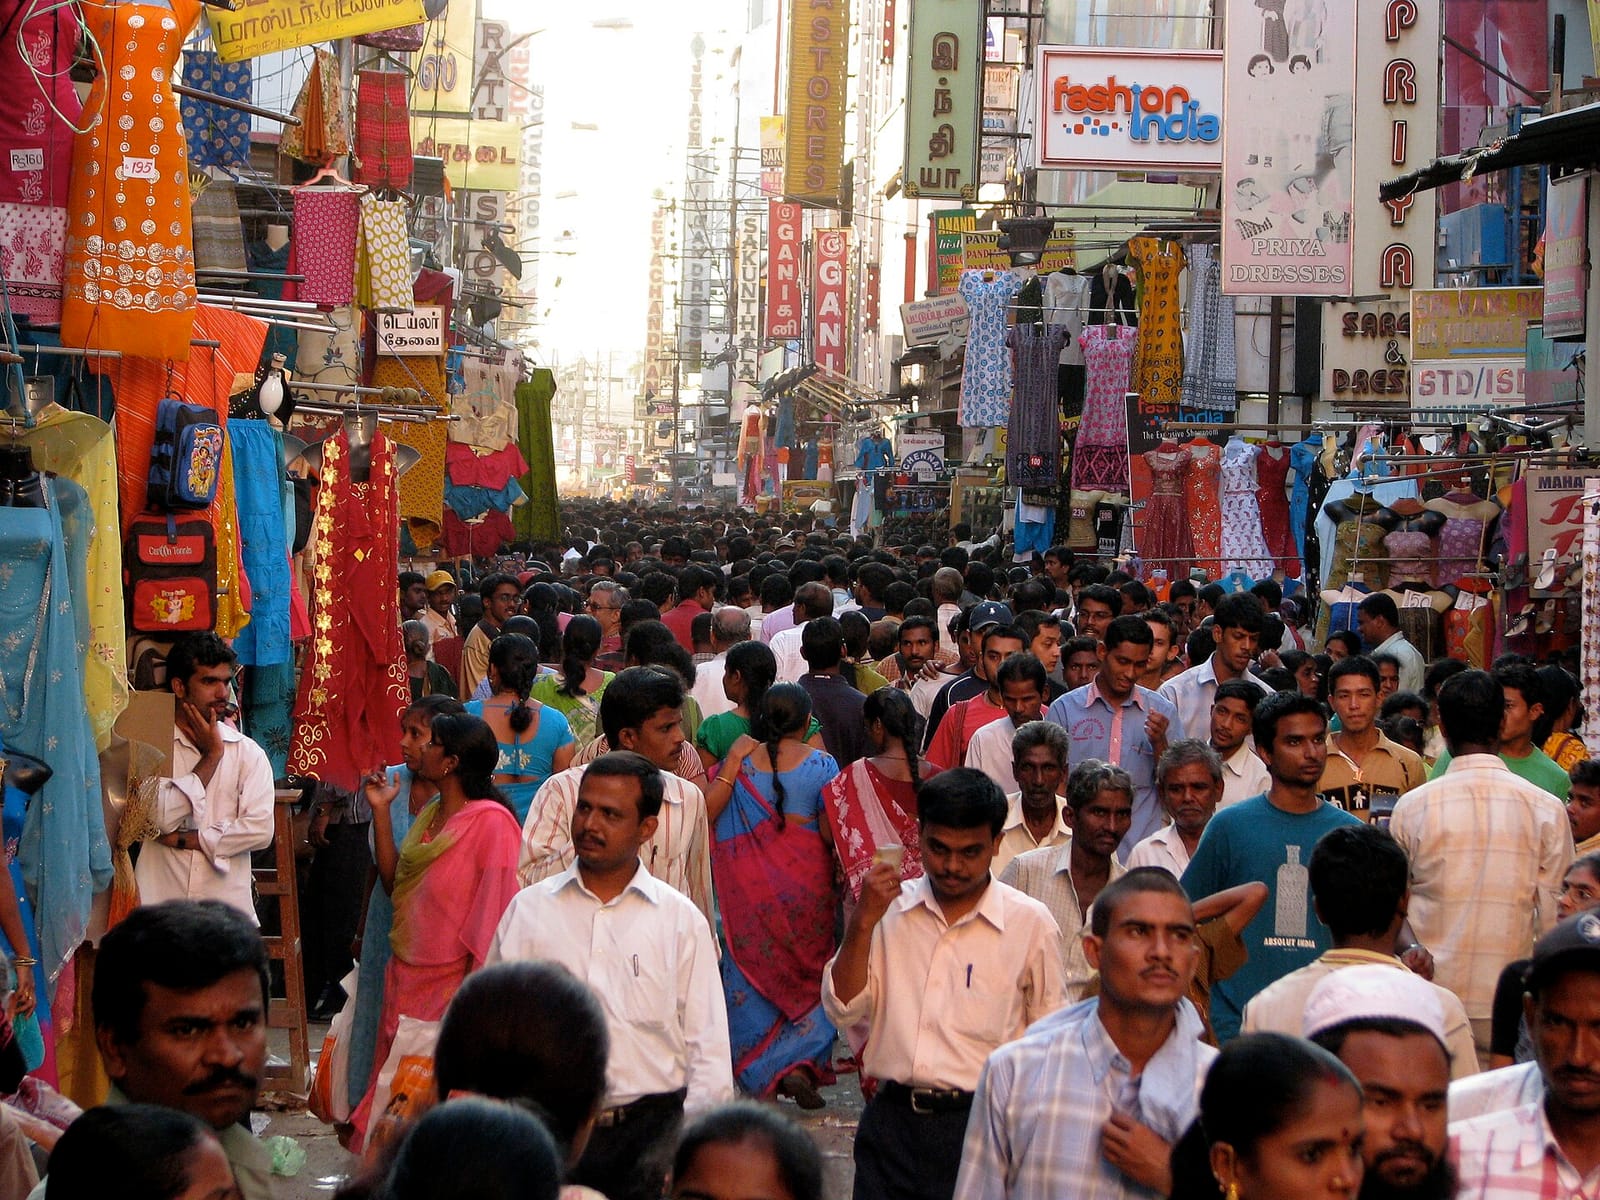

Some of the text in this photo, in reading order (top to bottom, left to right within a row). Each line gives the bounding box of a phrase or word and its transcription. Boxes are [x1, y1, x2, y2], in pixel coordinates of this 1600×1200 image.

[1054, 76, 1190, 114] fashion
[919, 31, 961, 189] இந்தியா
[1379, 0, 1418, 288] PRIYA
[131, 161, 152, 174] 195
[938, 215, 976, 234] ANAND
[1252, 238, 1326, 256] PRIYA
[777, 223, 794, 301] GANI
[1231, 264, 1345, 283] DRESSES
[738, 217, 759, 380] SAKUNTHALA
[384, 311, 439, 329] டெய்லர்
[772, 304, 797, 336] கனி
[819, 260, 842, 378] GANI
[385, 333, 439, 348] தேவை
[1385, 340, 1406, 365] &
[1332, 369, 1410, 394] DRES
[1142, 431, 1154, 440] The
[902, 451, 942, 471] CHENNAI
[1072, 508, 1086, 517] 230
[1263, 937, 1316, 948] ABSOLUT INDIA
